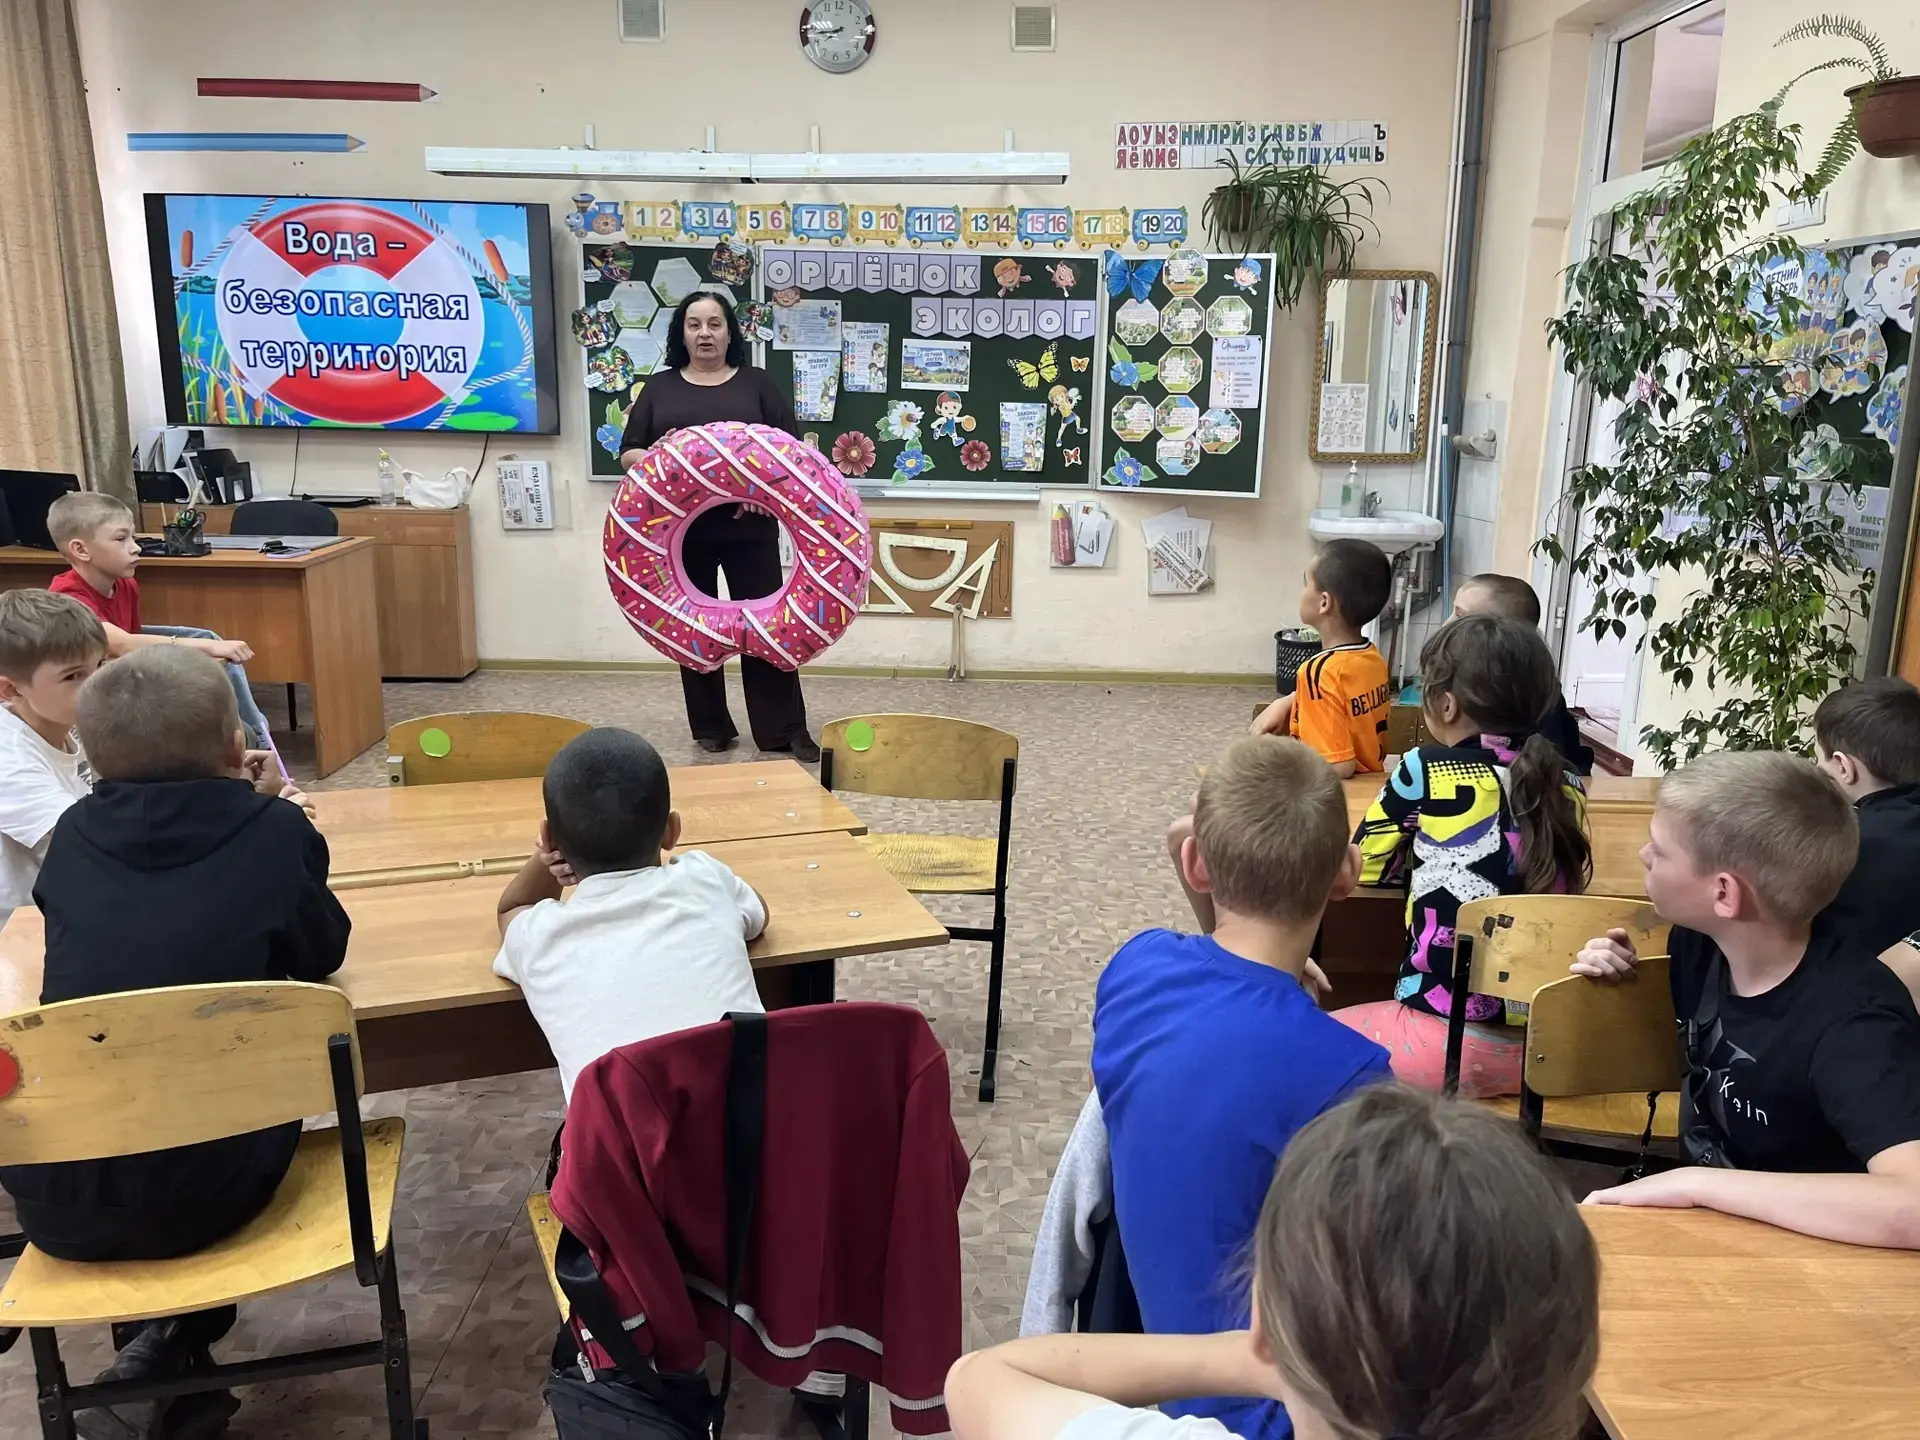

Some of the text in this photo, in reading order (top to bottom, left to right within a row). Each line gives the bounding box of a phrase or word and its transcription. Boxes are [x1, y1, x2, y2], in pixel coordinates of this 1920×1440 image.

[824, 3, 831, 12] 11
[835, 1, 844, 10] 12
[855, 15, 861, 24] 2
[853, 42, 859, 51] 4
[821, 48, 827, 57] 7
[832, 52, 839, 61] 6
[845, 51, 851, 60] 5
[636, 208, 1182, 233] 1 2 3 4 5 6 7 8 9 10 11 12 13 14 15 16 17 18 19 20
[283, 221, 378, 262] Вода
[767, 255, 978, 289] ОРЛЁНОК
[223, 279, 469, 320] безопасная
[915, 306, 1091, 333] ЭКОЛОГ
[240, 339, 467, 380] территория
[1848, 525, 1880, 539] МОЖЕМ
